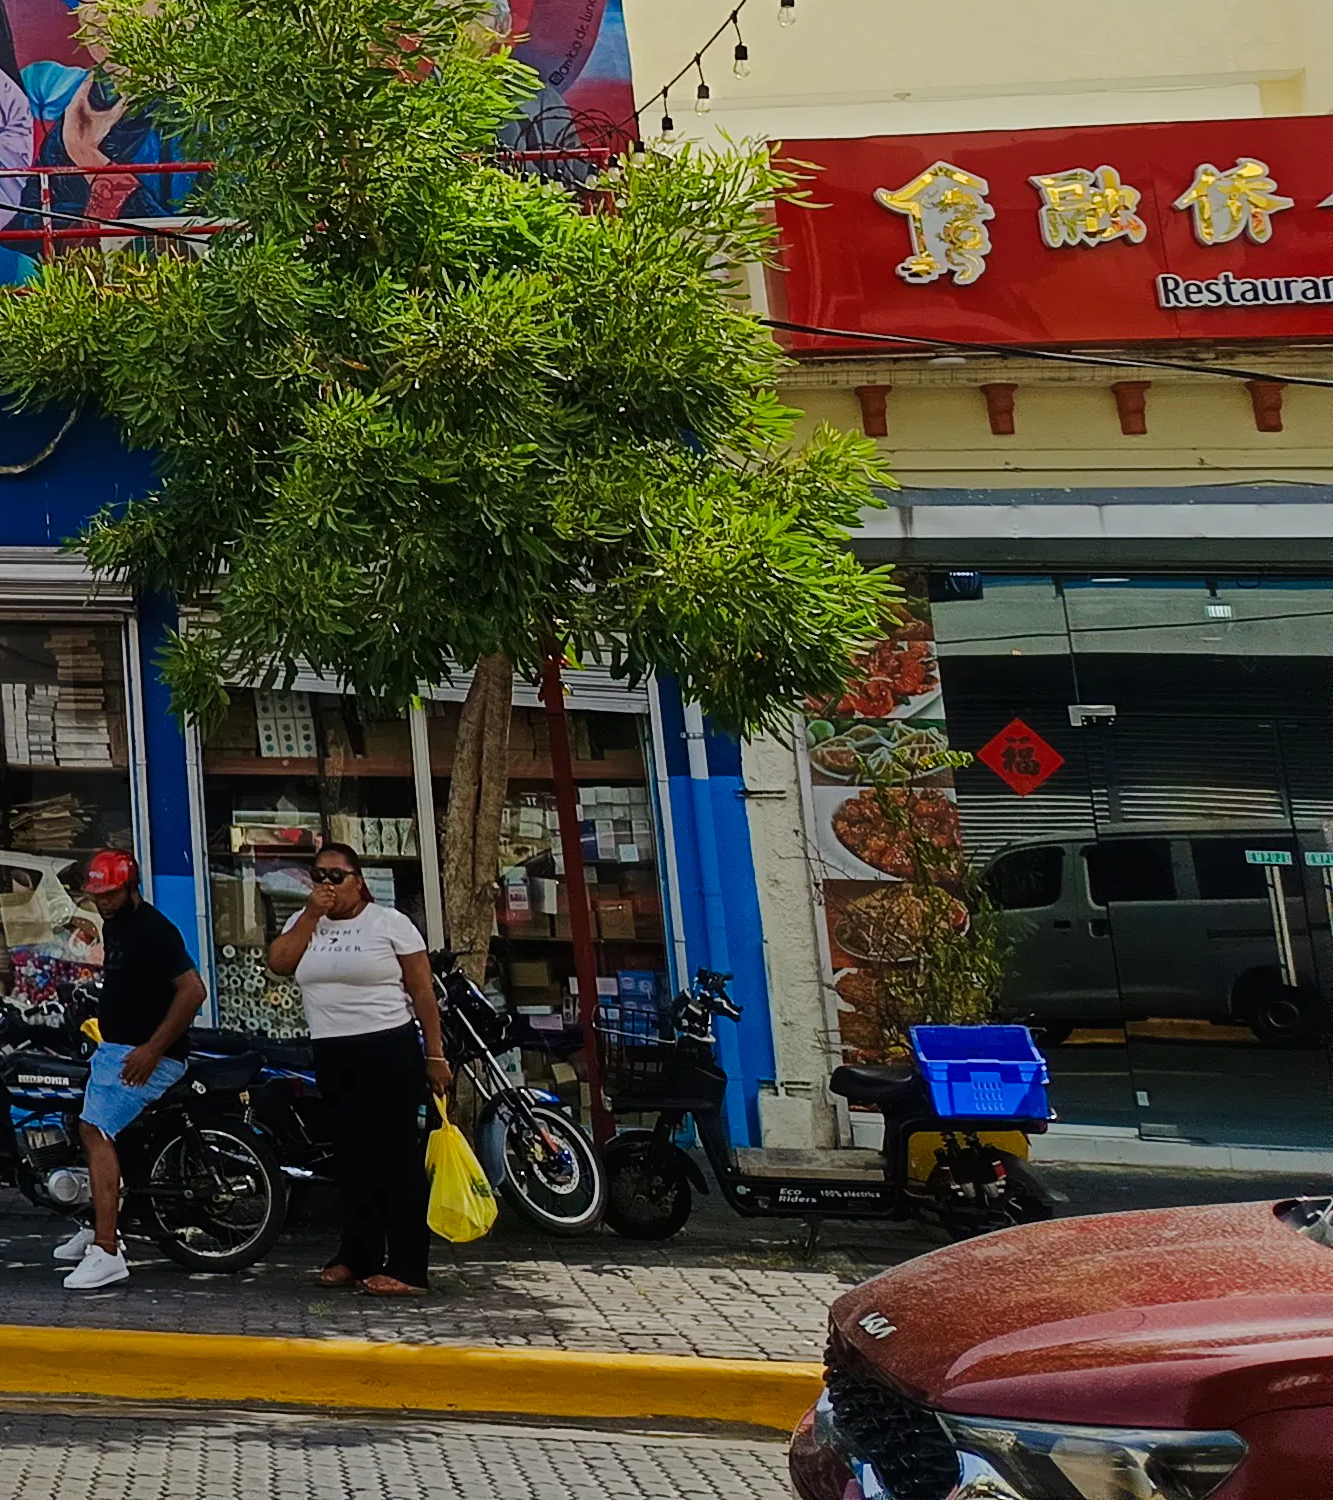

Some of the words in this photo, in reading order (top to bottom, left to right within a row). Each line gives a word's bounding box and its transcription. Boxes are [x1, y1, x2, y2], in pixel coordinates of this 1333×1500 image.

[1001, 735, 1042, 777] 福
[315, 927, 362, 937] OMMY
[779, 1188, 802, 1196] Eco
[820, 1189, 842, 1198] 100%
[778, 1195, 818, 1204] Riders
